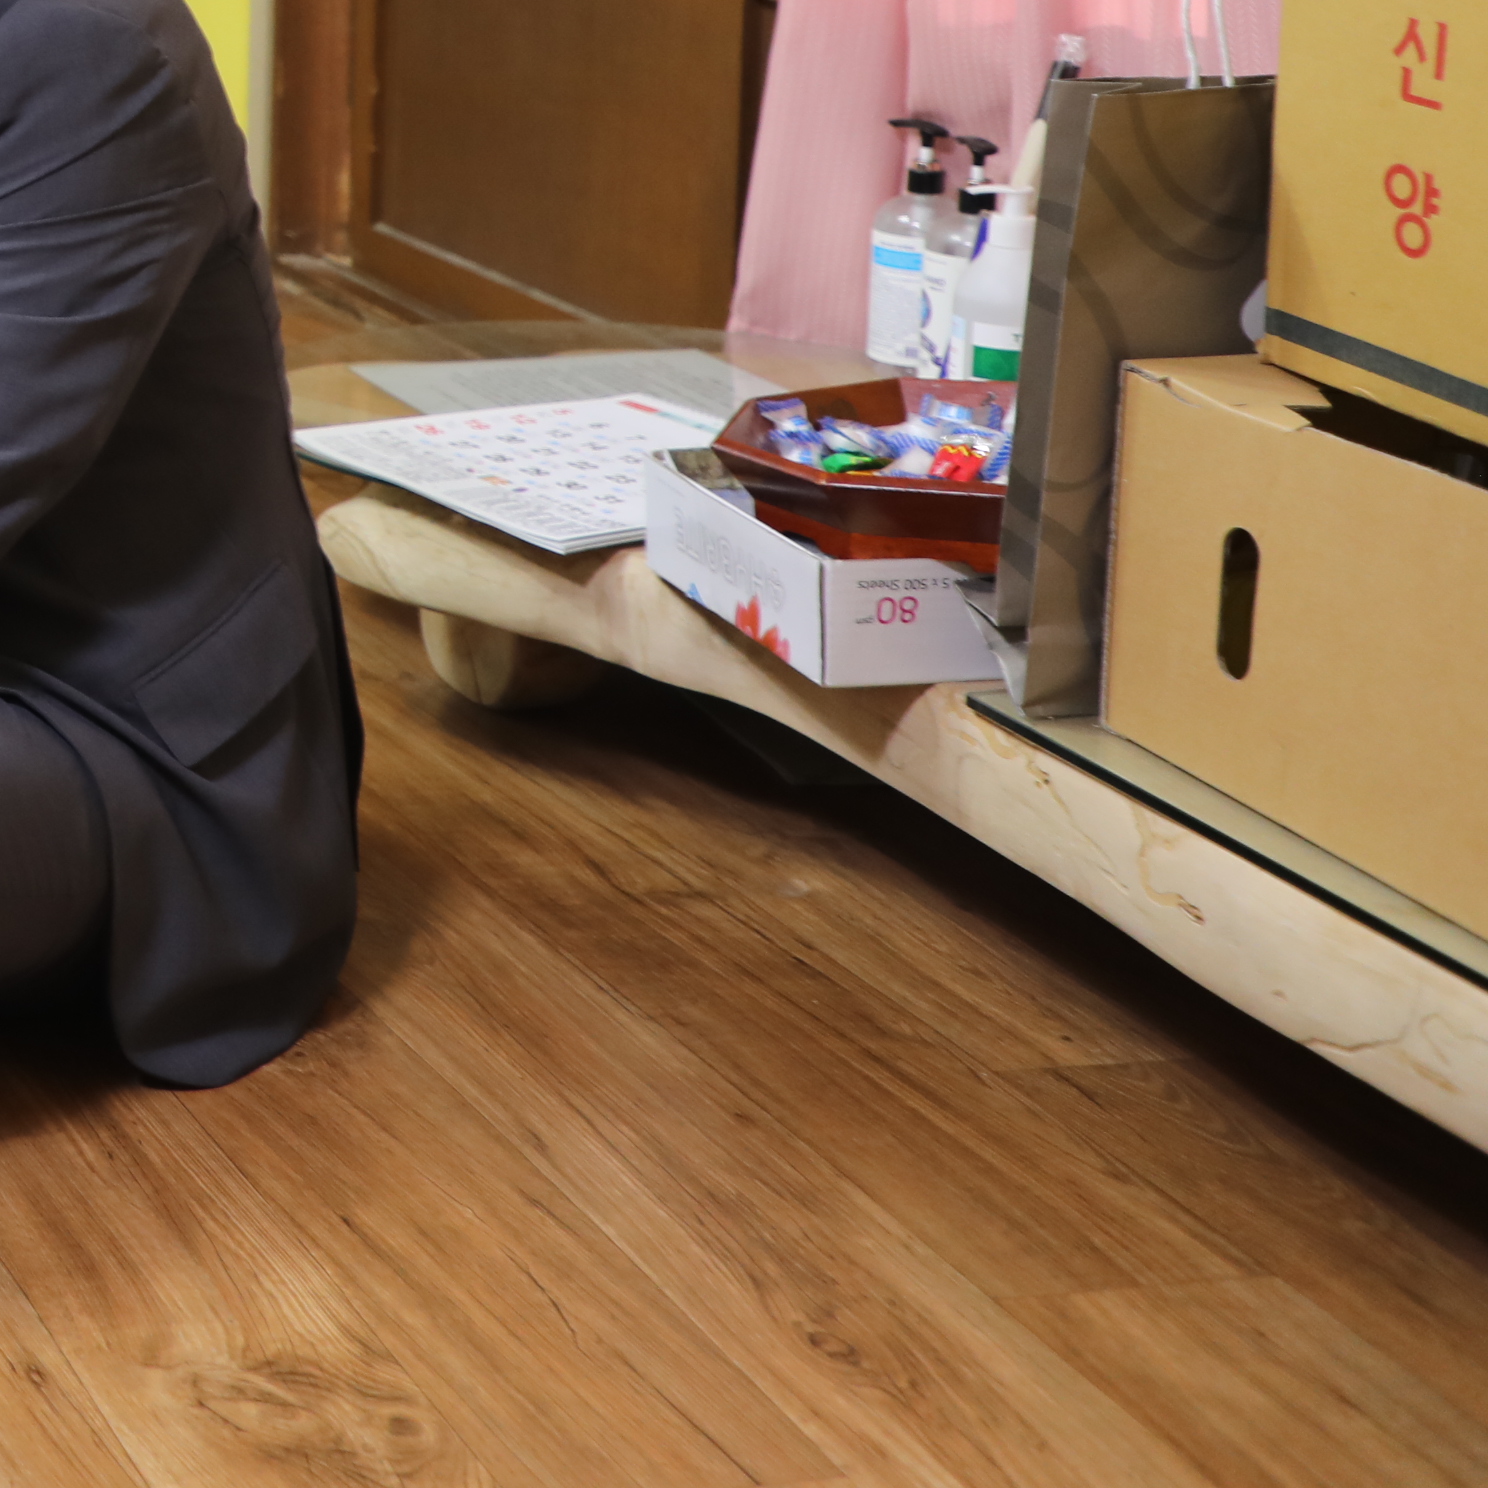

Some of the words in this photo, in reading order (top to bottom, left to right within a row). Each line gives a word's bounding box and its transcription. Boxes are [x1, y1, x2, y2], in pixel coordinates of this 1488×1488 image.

[858, 579, 900, 591] Sheets
[904, 579, 928, 591] 500
[877, 595, 920, 625] 80
